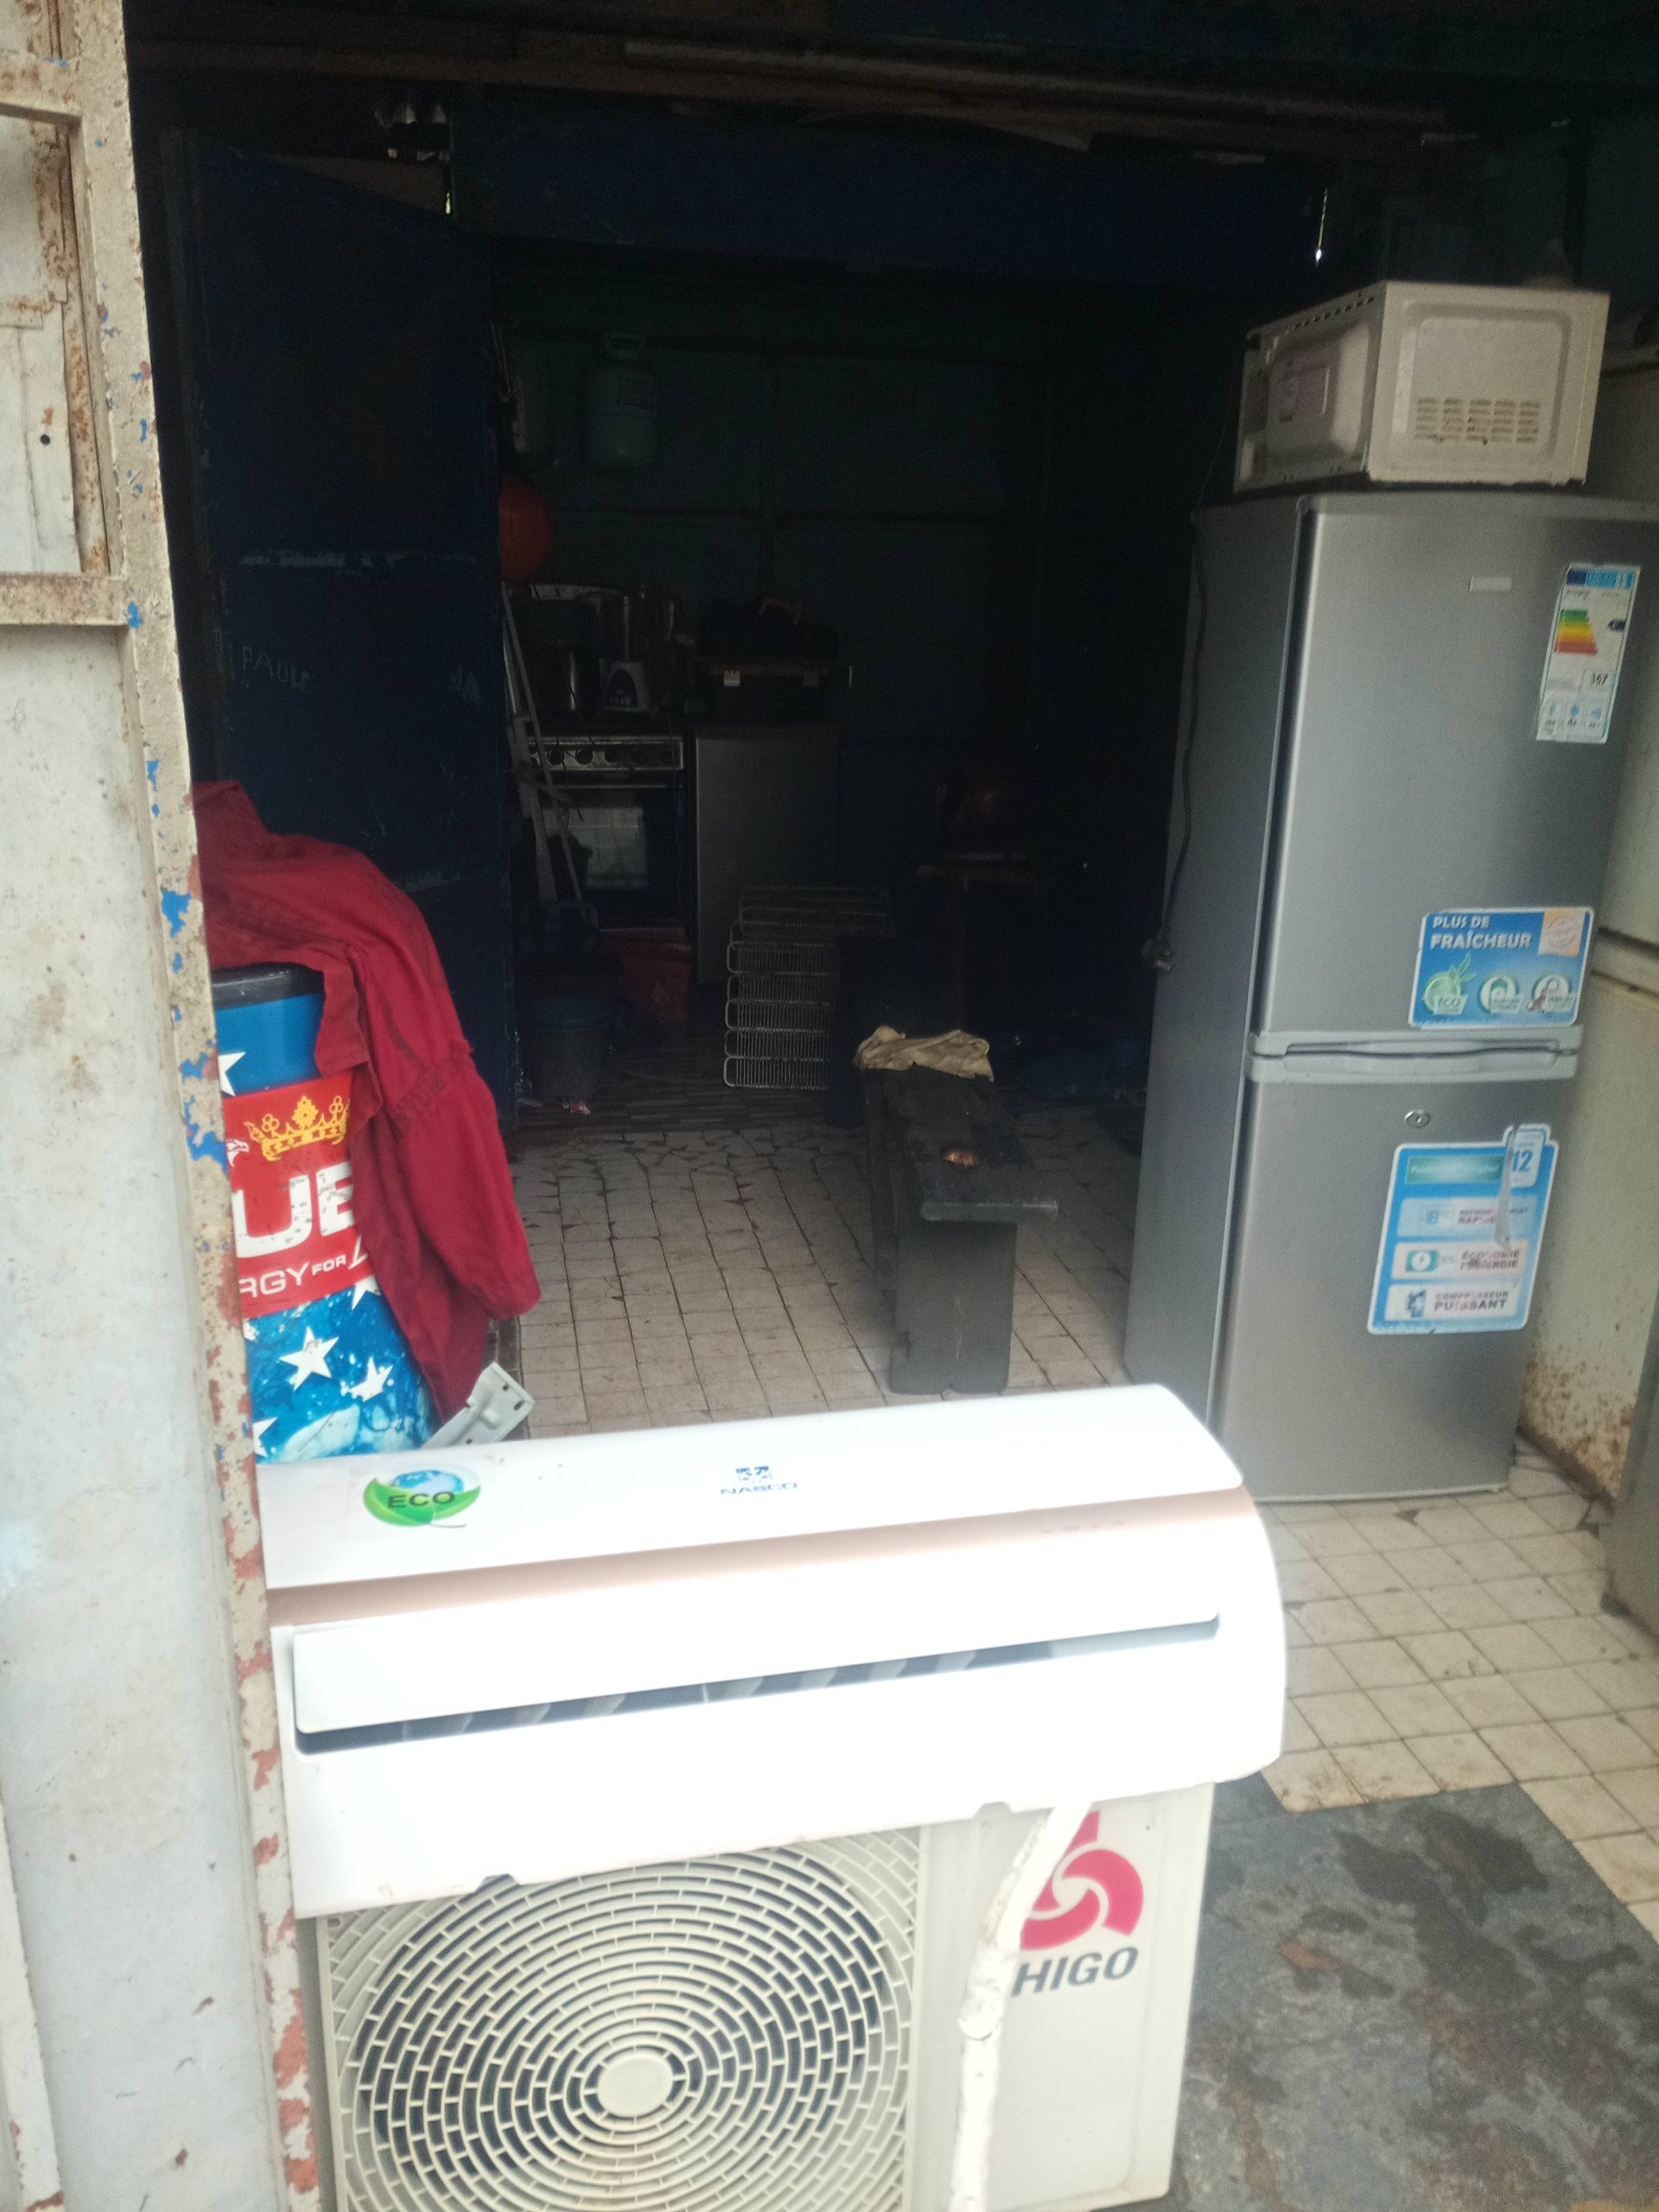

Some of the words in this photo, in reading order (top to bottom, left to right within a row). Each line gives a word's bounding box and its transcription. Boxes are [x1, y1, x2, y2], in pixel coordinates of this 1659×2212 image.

[1433, 915, 1467, 929] PLUS
[1471, 915, 1491, 929] DE
[1430, 930, 1532, 950] FRAÎCHEUR
[1512, 1149, 1534, 1173] 12
[312, 1255, 346, 1276] FOR
[387, 1491, 455, 1509] ECO
